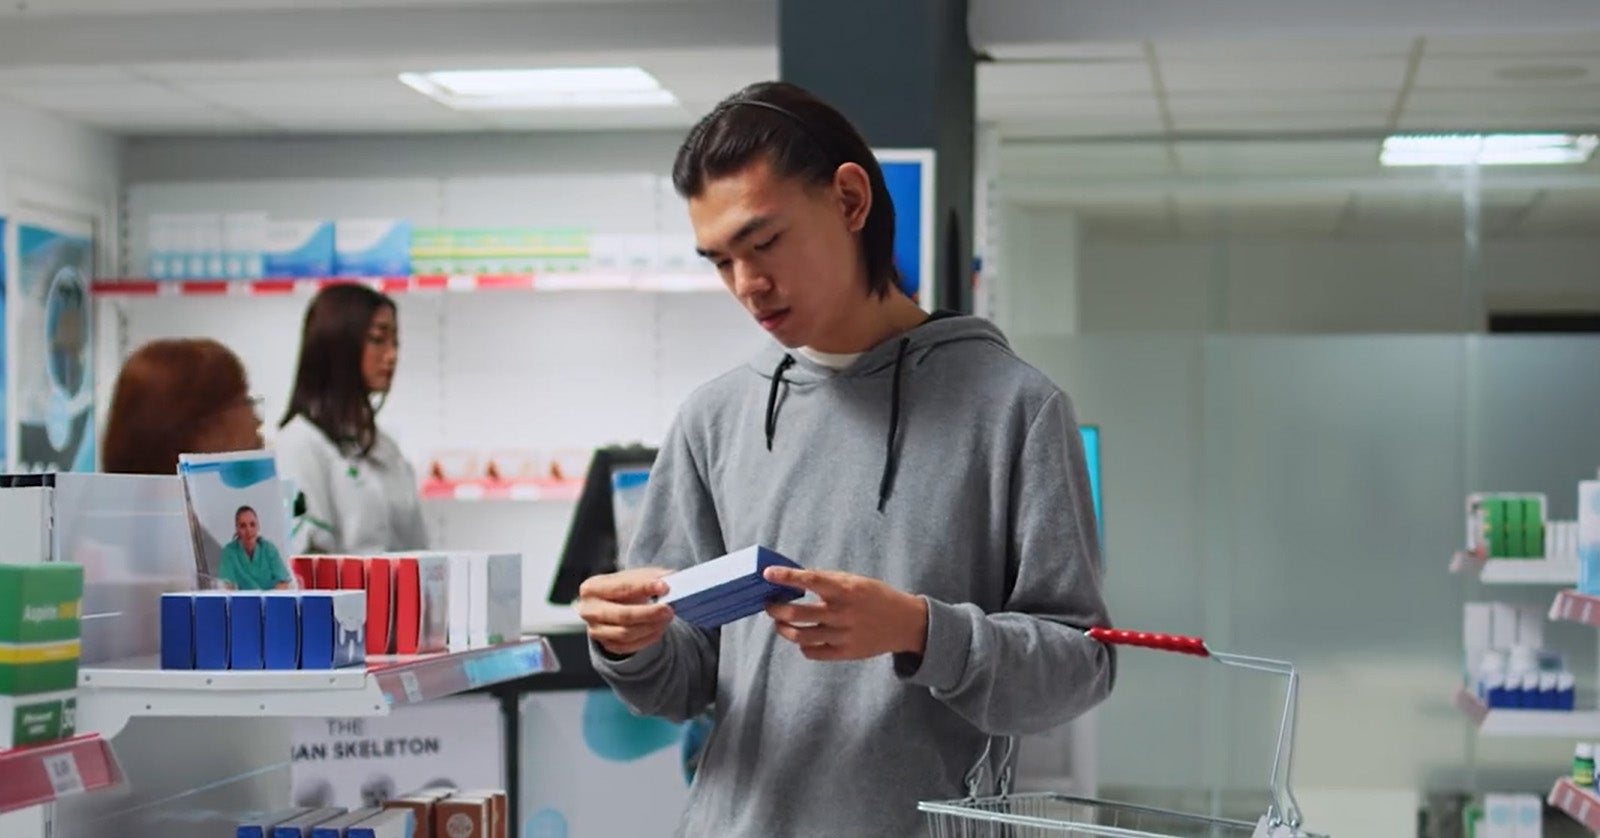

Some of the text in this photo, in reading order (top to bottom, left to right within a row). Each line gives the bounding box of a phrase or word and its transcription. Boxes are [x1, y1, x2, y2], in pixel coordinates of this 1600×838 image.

[327, 717, 363, 735] THE
[291, 736, 439, 760] AN SKELETON
